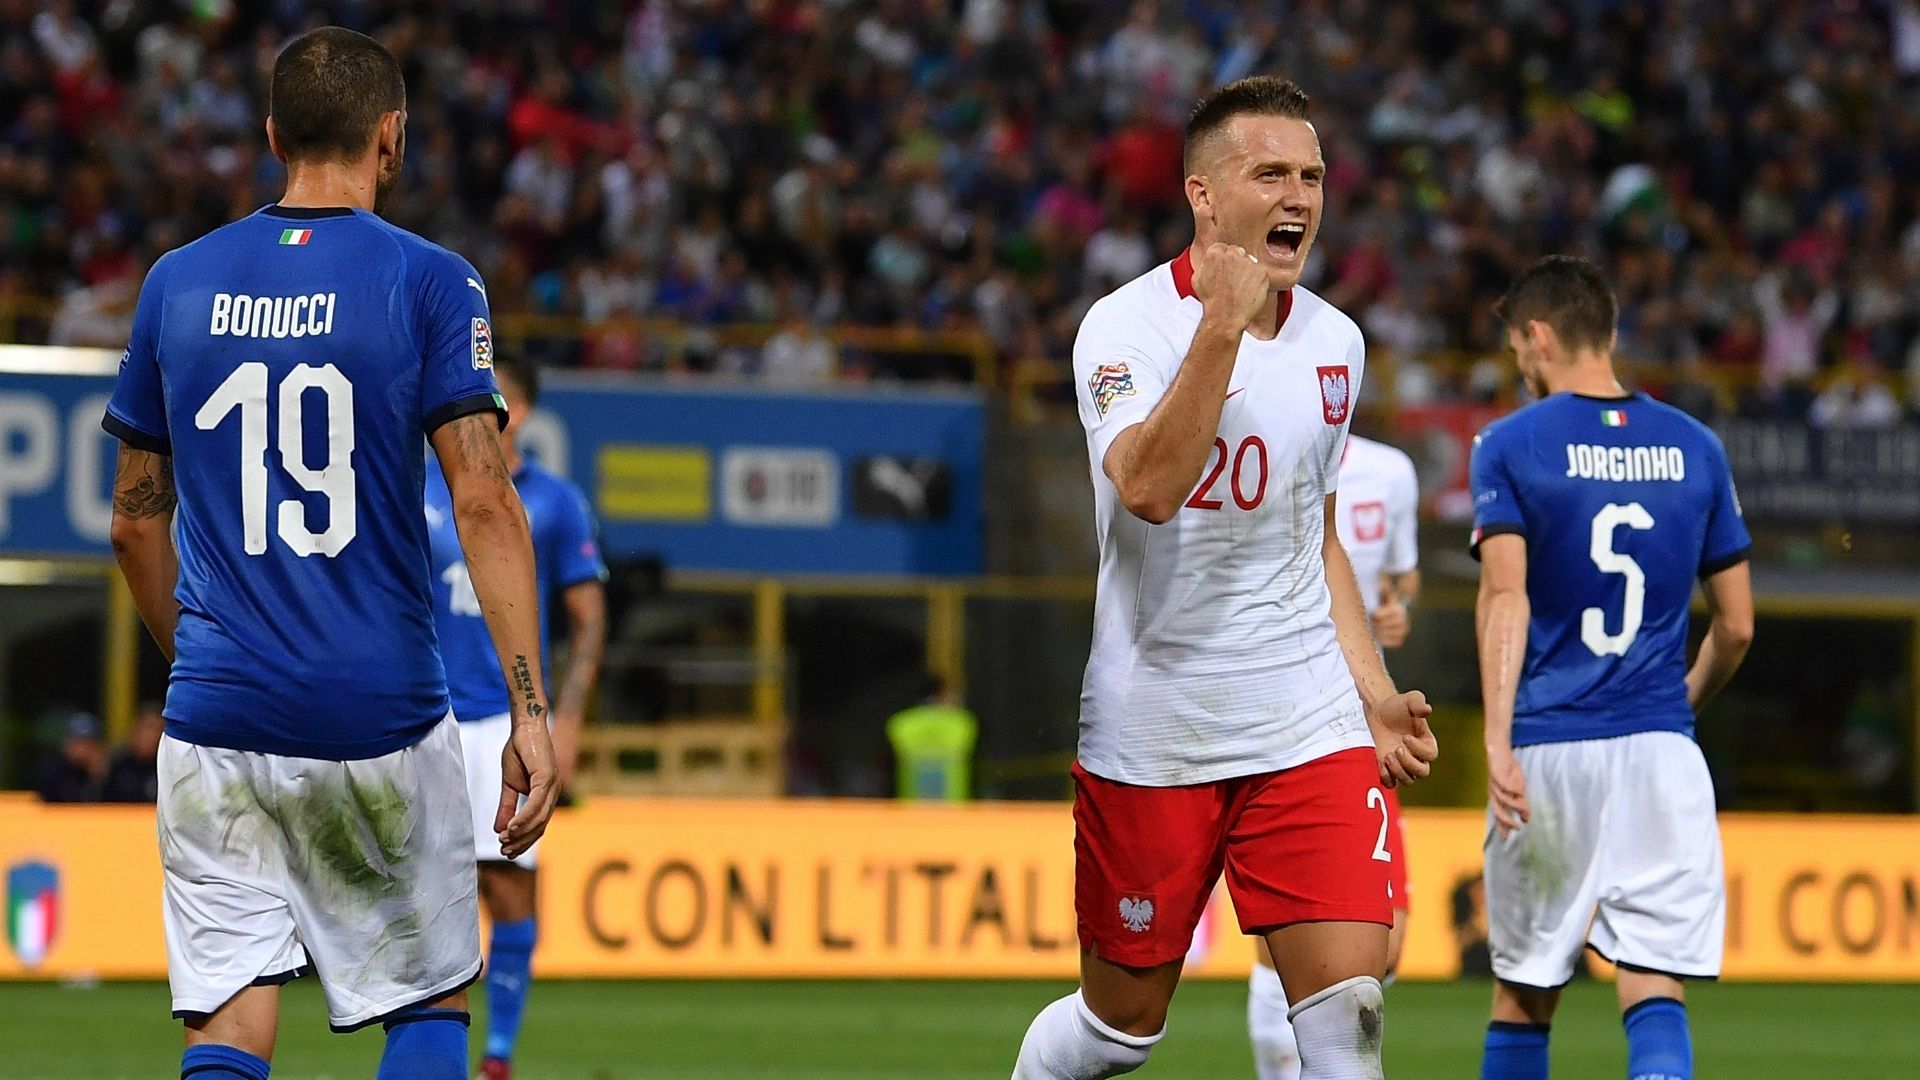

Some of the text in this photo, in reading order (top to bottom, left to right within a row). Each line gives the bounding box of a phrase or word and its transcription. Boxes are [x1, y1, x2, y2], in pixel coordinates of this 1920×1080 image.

[210, 292, 336, 338] BONUCCI
[194, 361, 357, 558] 19
[1185, 435, 1269, 512] 20
[1565, 443, 1686, 482] JORGINHO
[1581, 501, 1656, 657] 5
[583, 858, 779, 951] CON
[816, 861, 1079, 951] L'ITAL
